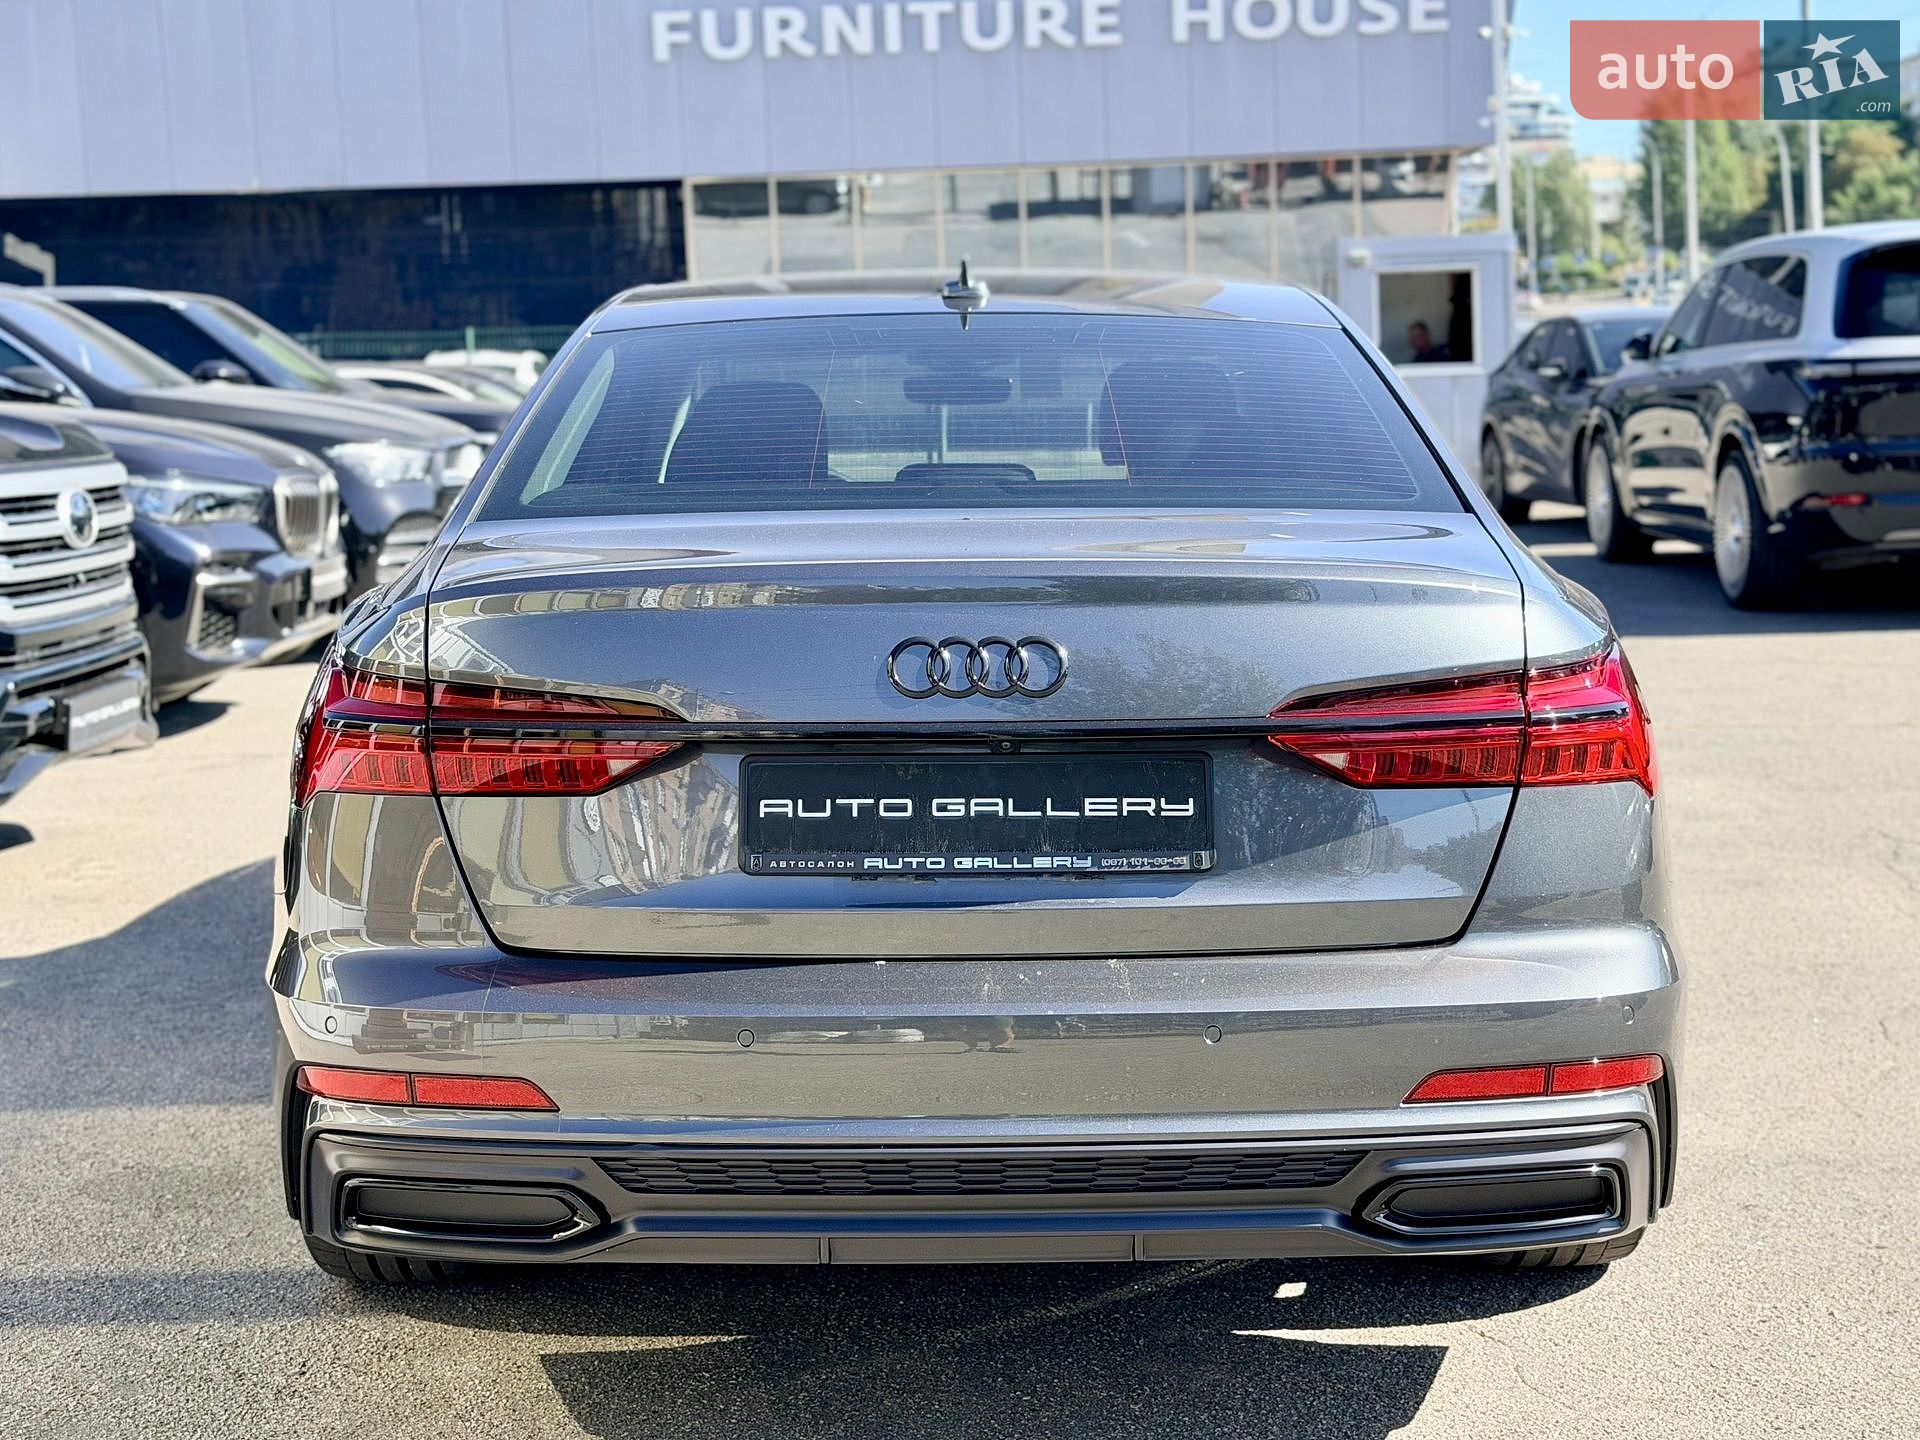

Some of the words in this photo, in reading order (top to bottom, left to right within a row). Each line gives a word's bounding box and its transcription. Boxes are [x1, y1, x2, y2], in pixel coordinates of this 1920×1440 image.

[651, 0, 1123, 62] FURNITURE
[1170, 0, 1450, 43] HOUSE
[759, 798, 913, 818] AUTO
[931, 797, 1194, 817] GALLERY
[769, 859, 855, 868] АВТОСАЛОН
[863, 857, 946, 869] AUTO
[953, 856, 1092, 869] GALLERY
